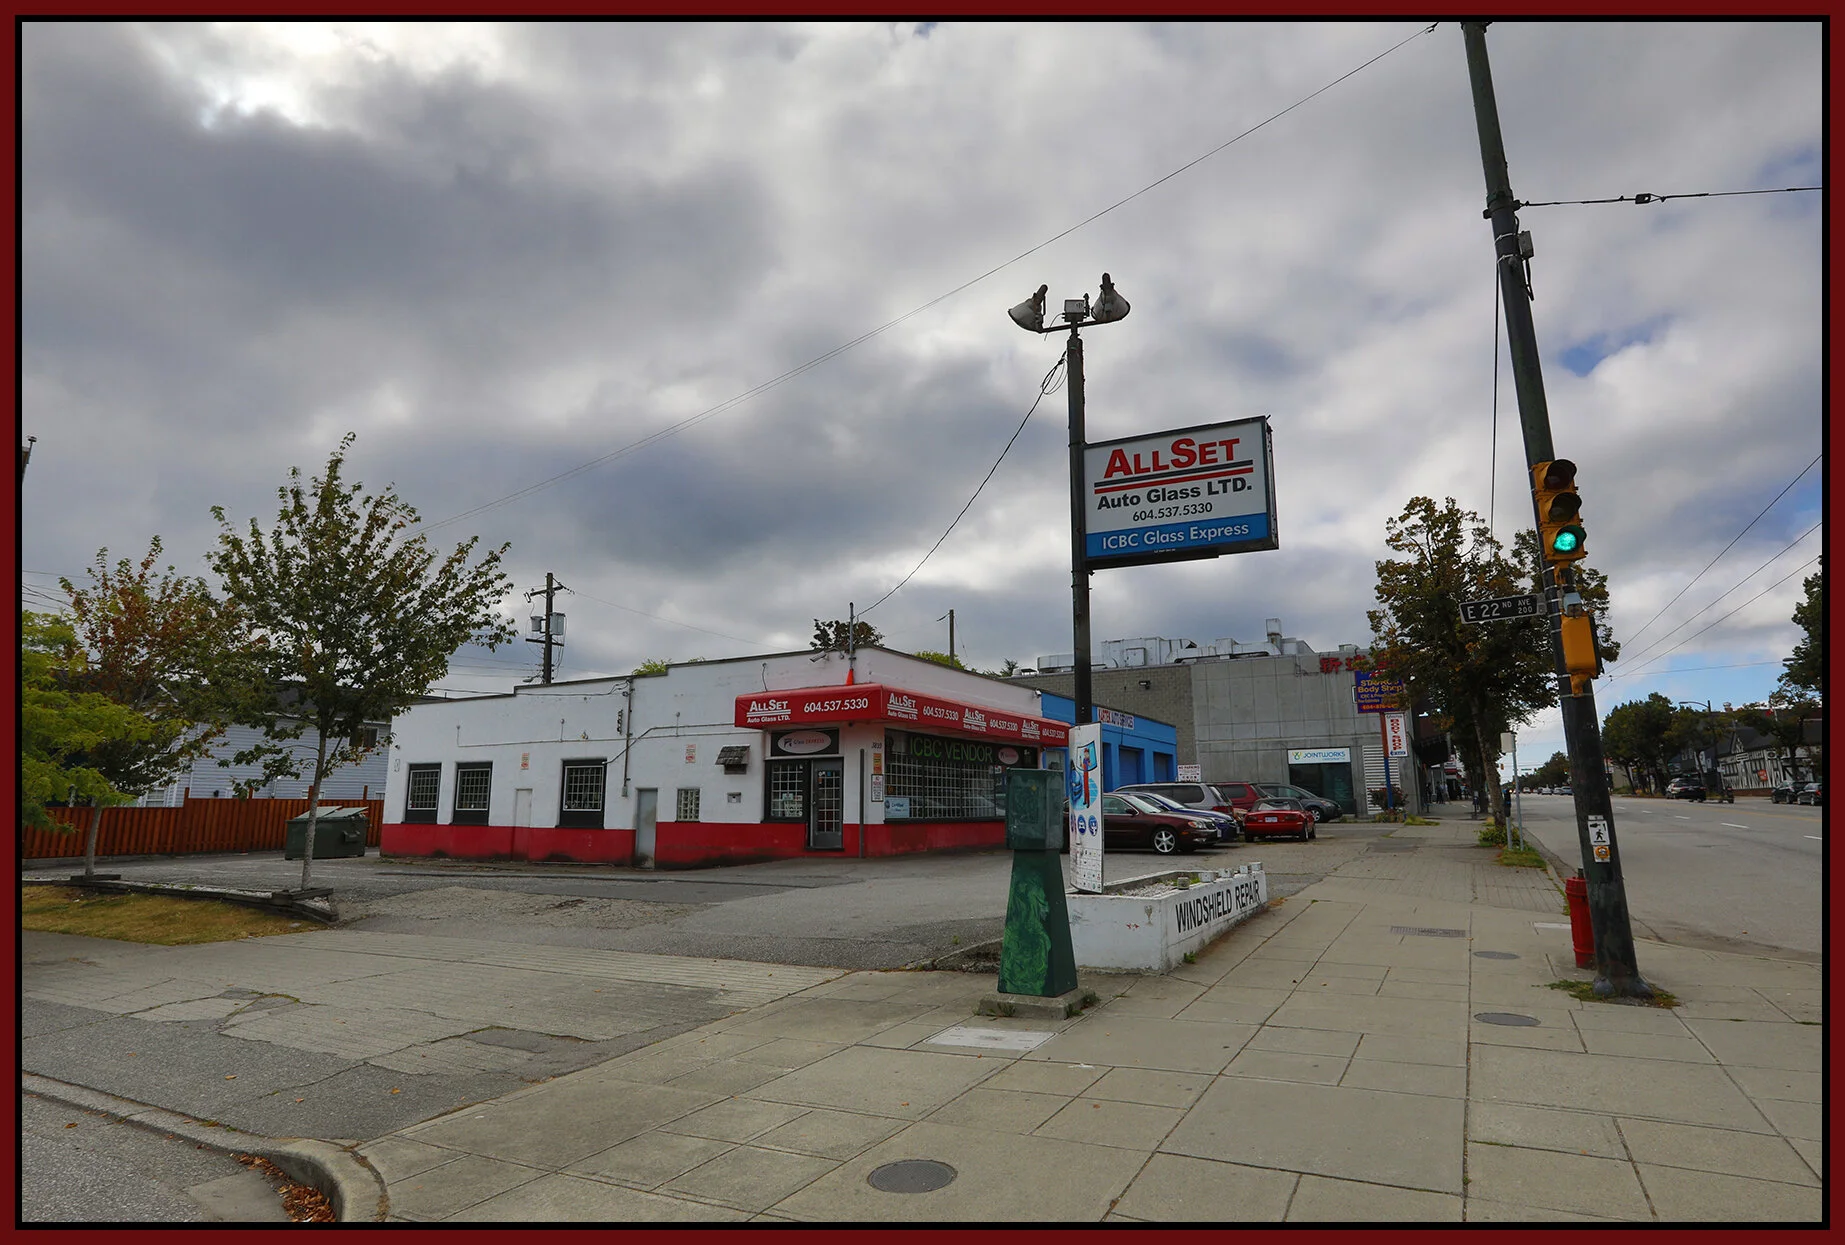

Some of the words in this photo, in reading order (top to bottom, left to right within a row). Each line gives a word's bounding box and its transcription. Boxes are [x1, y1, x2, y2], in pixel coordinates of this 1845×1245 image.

[1103, 437, 1240, 479] ALLSET
[1097, 495, 1141, 510] Auto
[1146, 486, 1201, 504] Glass
[1207, 477, 1252, 496] LTD.
[1132, 502, 1213, 522] 604.537.5330
[1102, 533, 1139, 550] ICBC
[1143, 529, 1184, 545] Glass
[1189, 524, 1249, 542] Express
[1467, 605, 1476, 620] E
[1517, 606, 1533, 614] 200
[749, 699, 788, 712] ALLSET
[803, 698, 869, 713] 604.537.5330
[922, 705, 959, 721] 604.537.5330
[989, 719, 1018, 731] 604.537.5330
[910, 736, 941, 758] ICBC
[944, 741, 993, 763] VENDOR
[1175, 888, 1233, 934] WINDSHIELD
[1234, 879, 1262, 910] REPAIR
